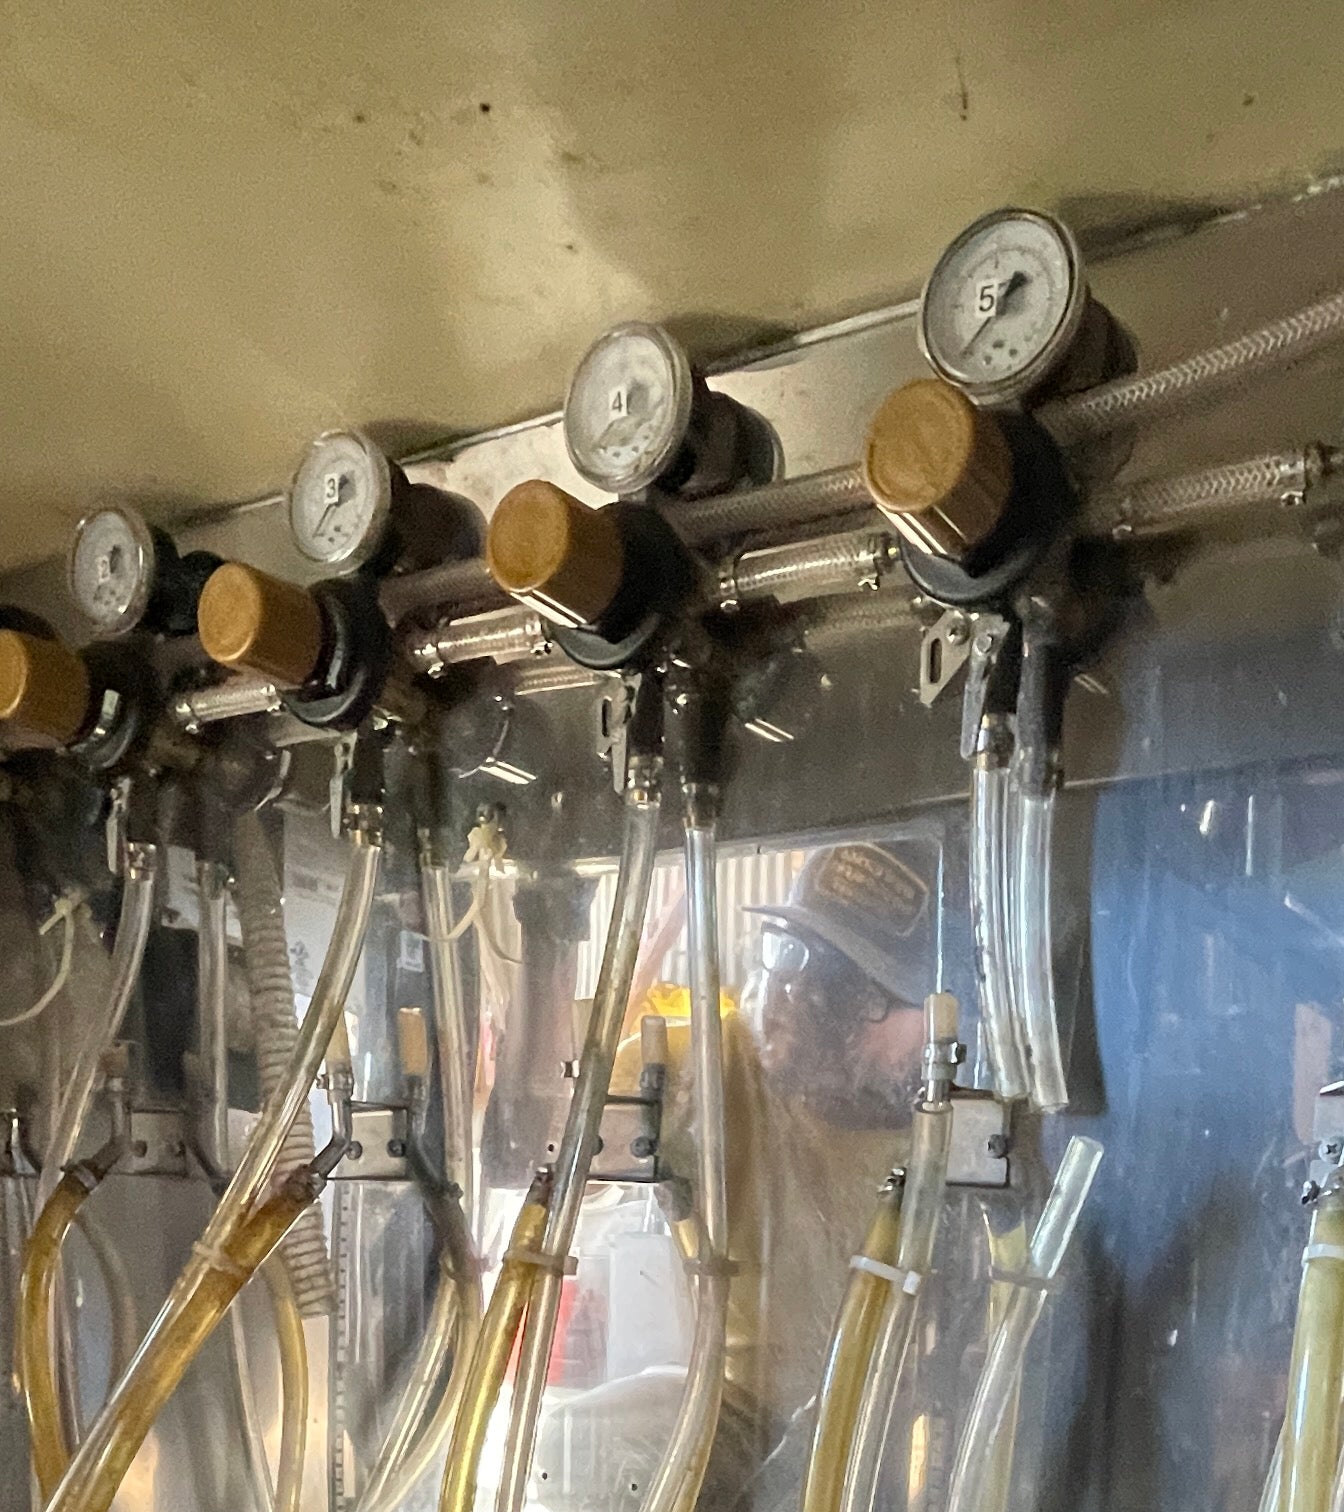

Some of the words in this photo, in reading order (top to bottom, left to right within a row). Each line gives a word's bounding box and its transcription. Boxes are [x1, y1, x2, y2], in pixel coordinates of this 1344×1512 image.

[978, 284, 996, 312] 5
[611, 391, 624, 413] 4
[326, 477, 336, 498] 3
